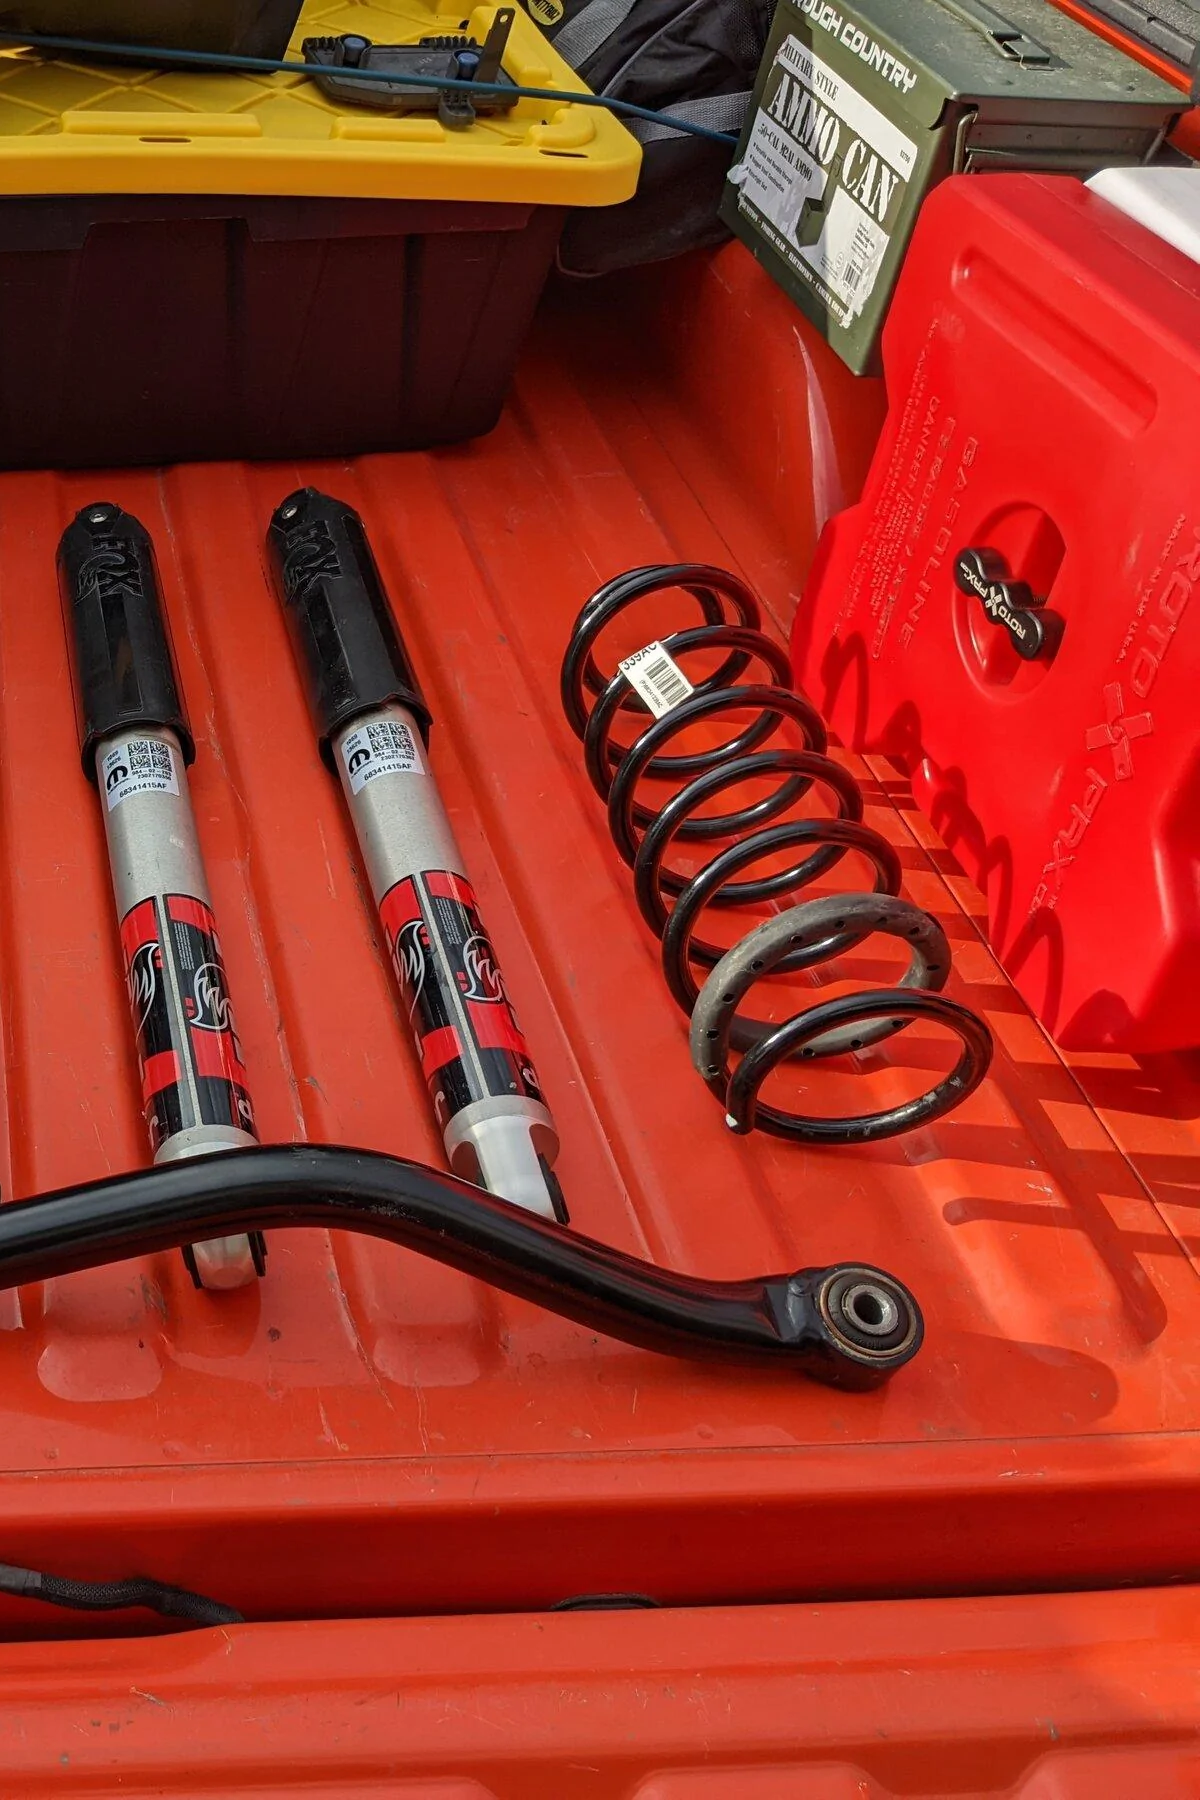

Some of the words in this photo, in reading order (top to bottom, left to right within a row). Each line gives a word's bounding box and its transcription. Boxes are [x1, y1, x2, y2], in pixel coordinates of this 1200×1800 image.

[815, 70, 839, 101] STYLE
[840, 23, 917, 94] COUNTRY
[767, 73, 840, 166] AMMO
[842, 139, 899, 222] CAN
[900, 436, 978, 649] GASOLINE
[120, 782, 167, 798] 68341415AF
